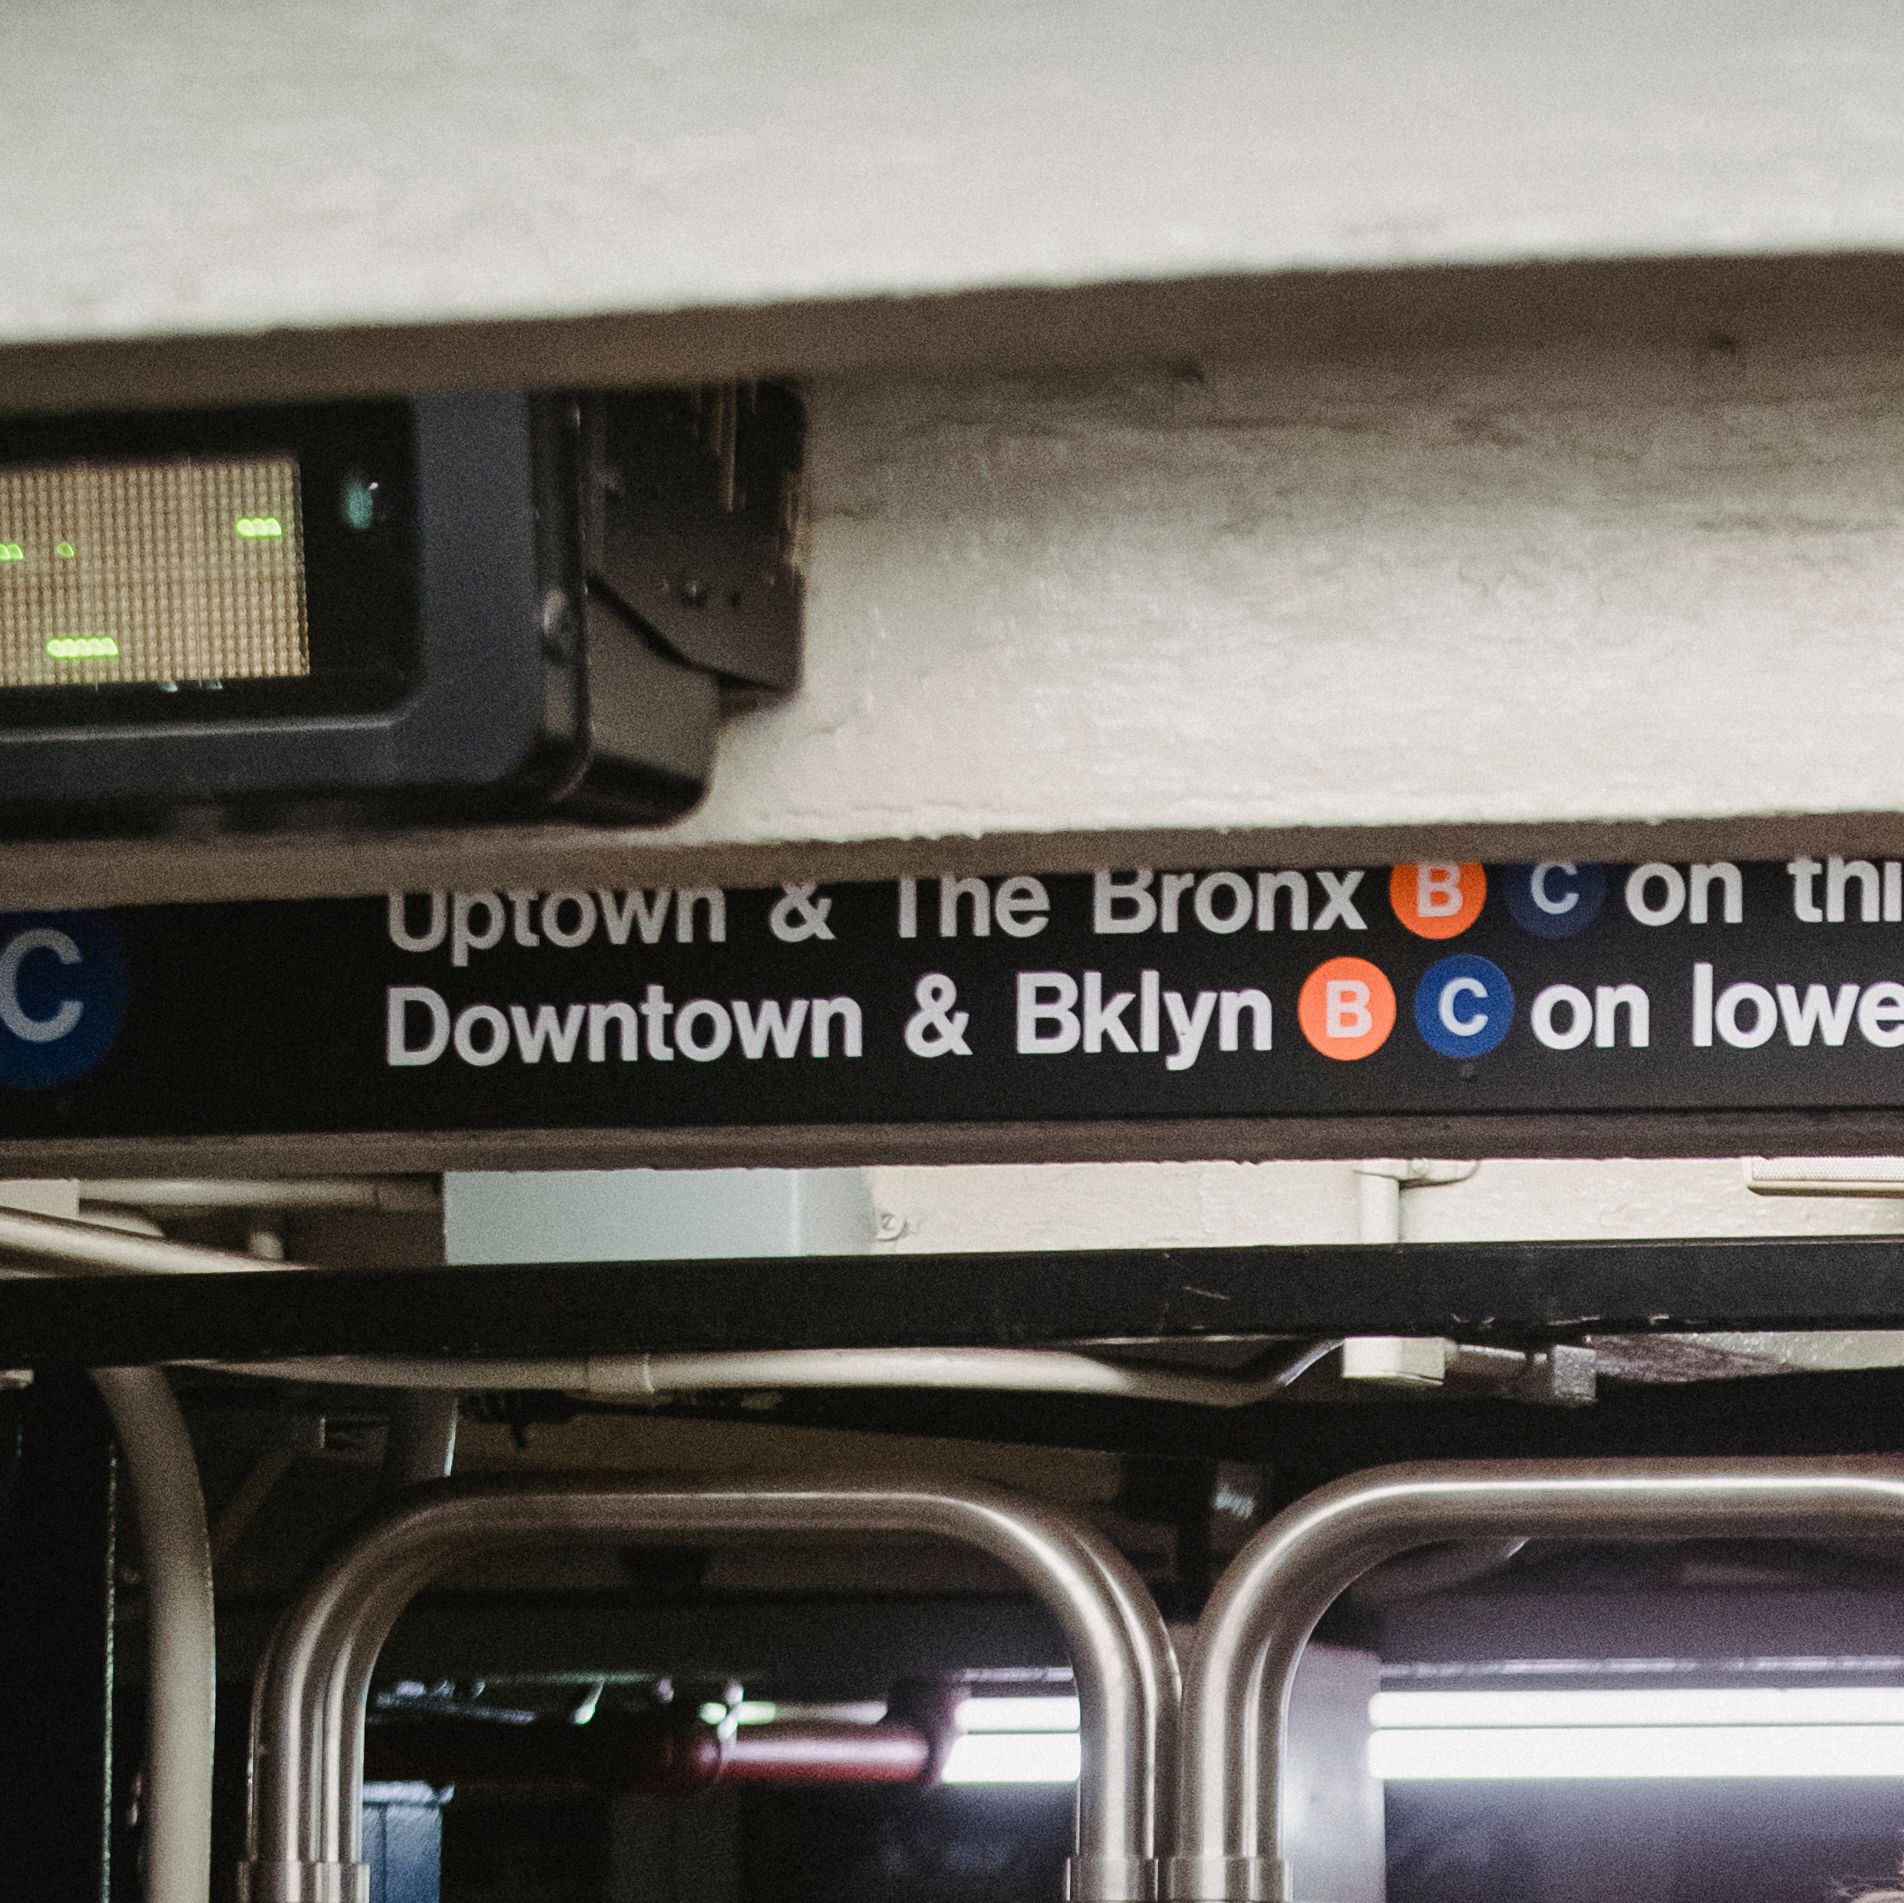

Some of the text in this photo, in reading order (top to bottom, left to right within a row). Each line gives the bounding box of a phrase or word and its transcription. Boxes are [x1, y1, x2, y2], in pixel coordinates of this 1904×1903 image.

[388, 888, 727, 967] Uptown
[769, 882, 836, 943] &
[898, 871, 1051, 938] The
[1093, 867, 1368, 934] Bronx
[1417, 863, 1464, 918] B
[1530, 861, 1580, 914] C
[1625, 862, 1743, 926] on
[0, 928, 85, 1042] C
[386, 985, 863, 1066] Downtown
[904, 972, 973, 1057] &
[1016, 969, 1273, 1071] Bklyn
[1326, 980, 1373, 1038] B
[1438, 977, 1489, 1037] C
[1530, 983, 1650, 1050] on
